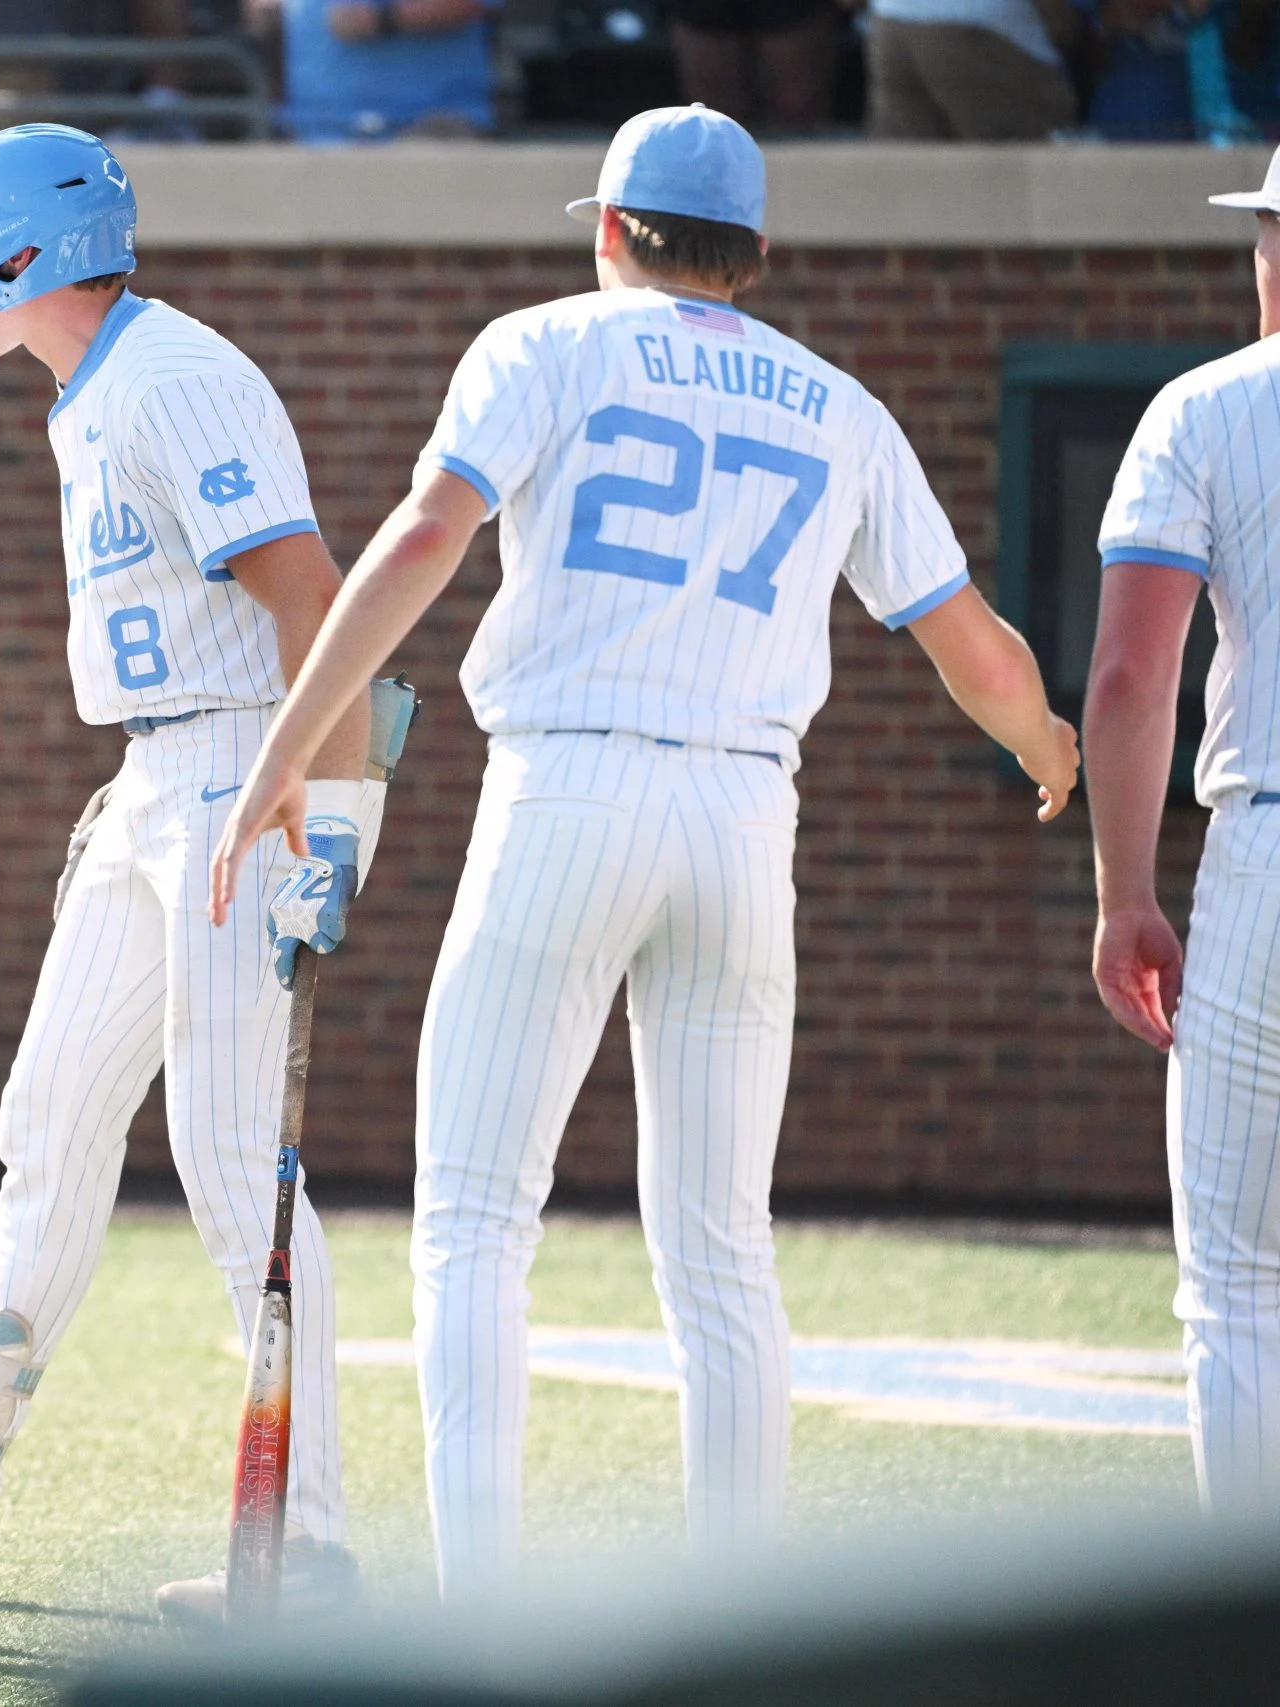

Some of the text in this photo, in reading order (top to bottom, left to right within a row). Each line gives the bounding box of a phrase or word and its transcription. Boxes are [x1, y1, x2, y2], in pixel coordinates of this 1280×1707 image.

[635, 333, 830, 425] GLAUBER
[562, 404, 830, 617] 27
[107, 605, 170, 691] 8
